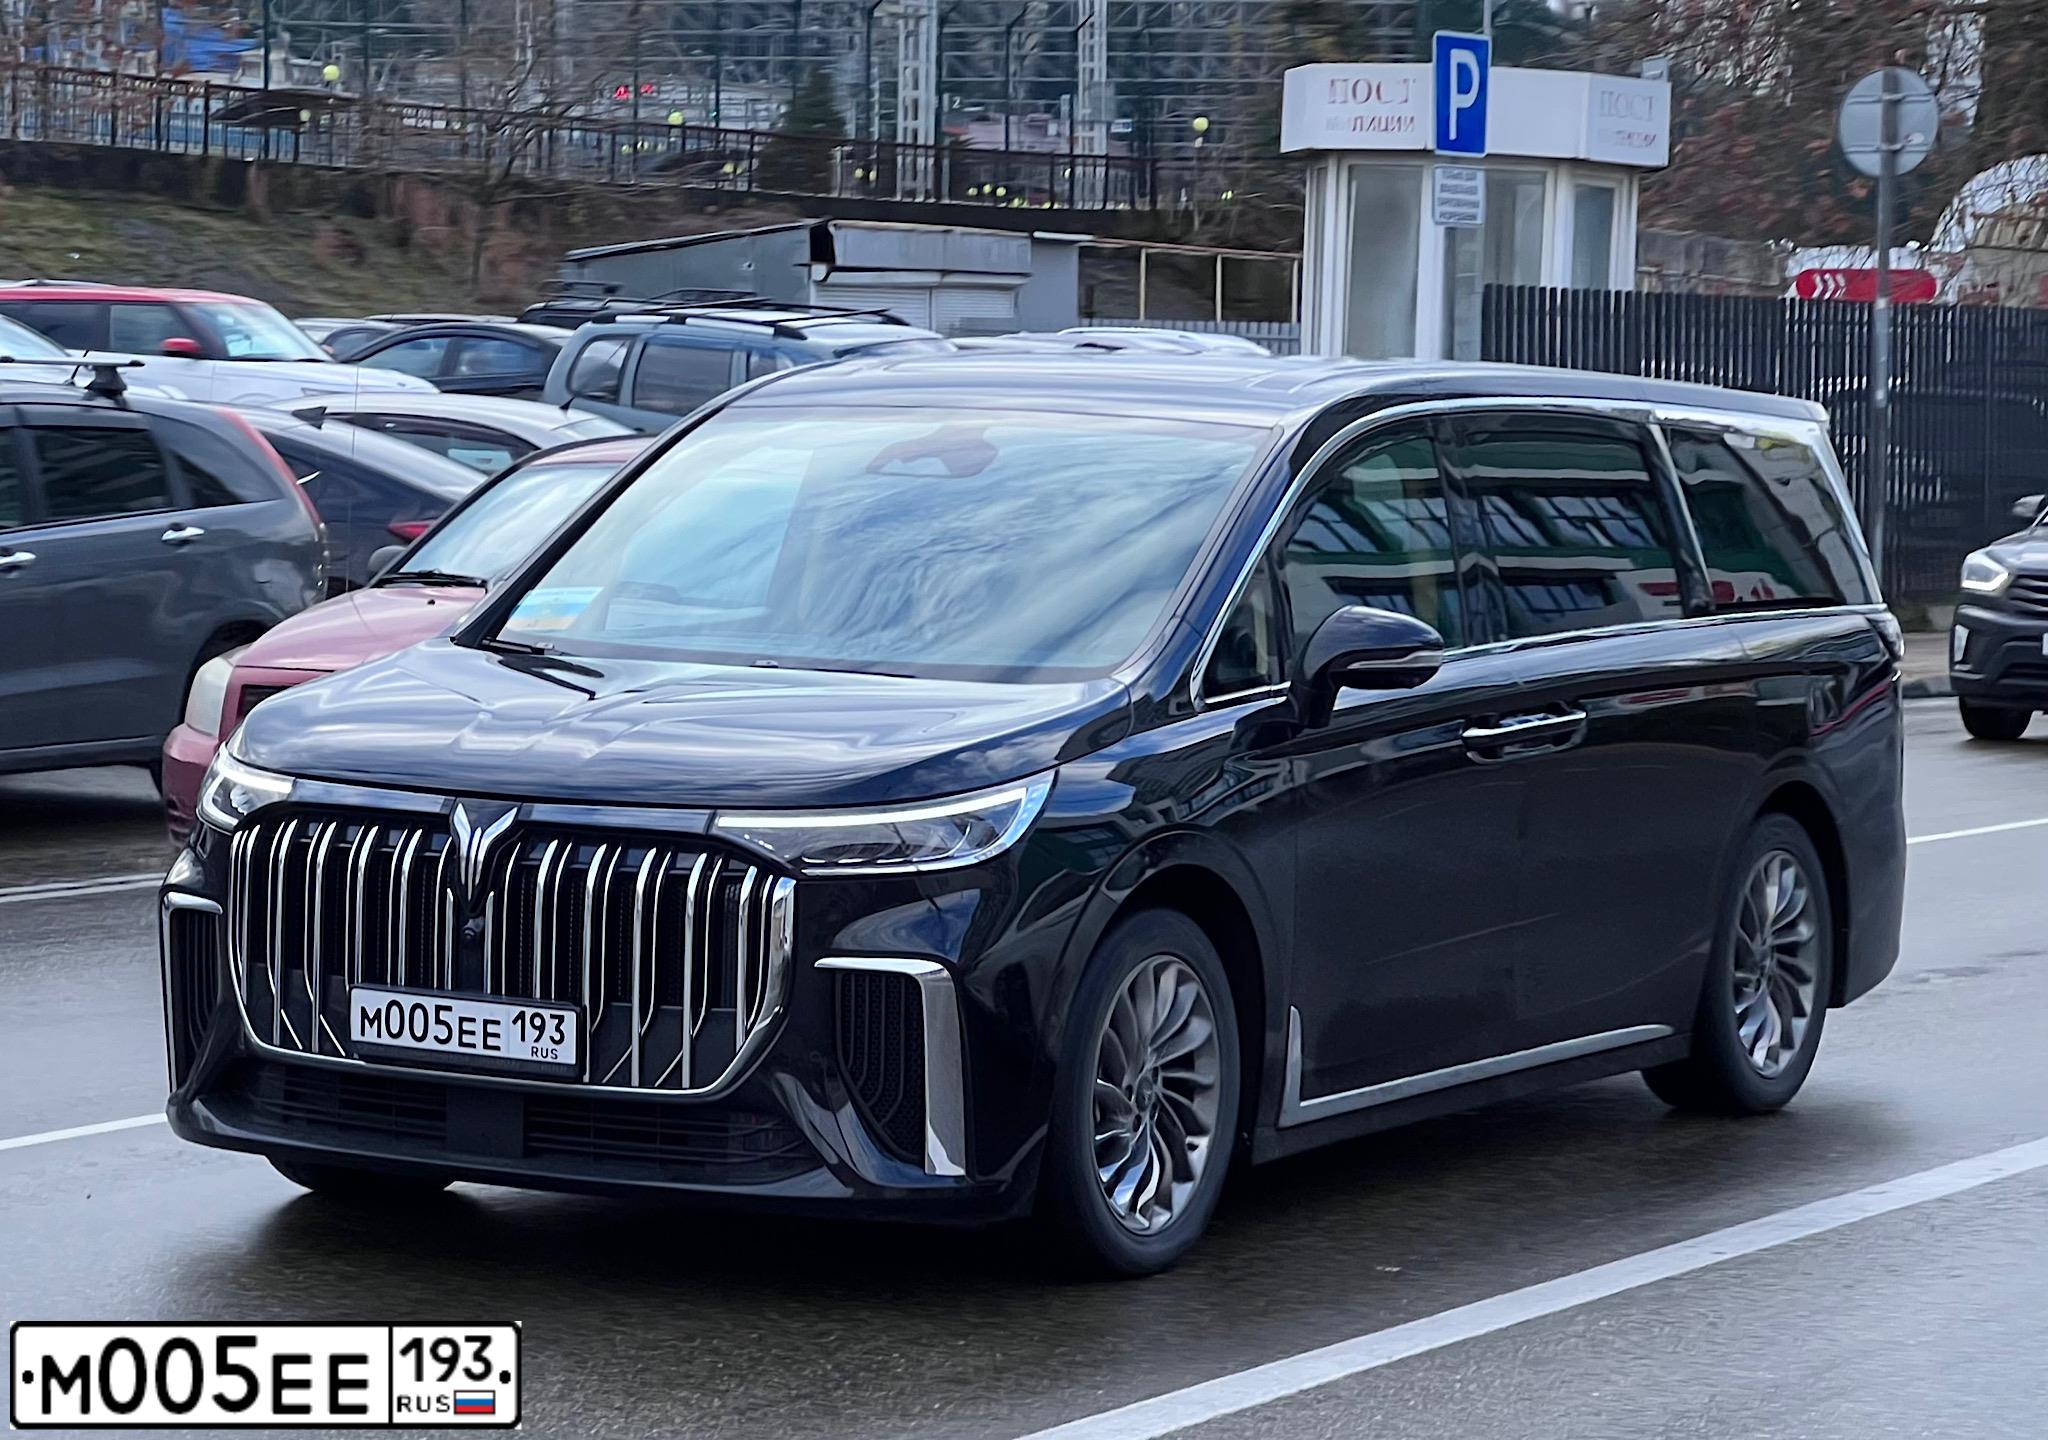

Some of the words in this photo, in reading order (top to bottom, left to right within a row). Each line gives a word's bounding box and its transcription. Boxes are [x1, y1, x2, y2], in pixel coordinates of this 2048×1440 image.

[1449, 48, 1480, 140] P
[511, 1010, 566, 1046] 193
[530, 1046, 559, 1060] RUS
